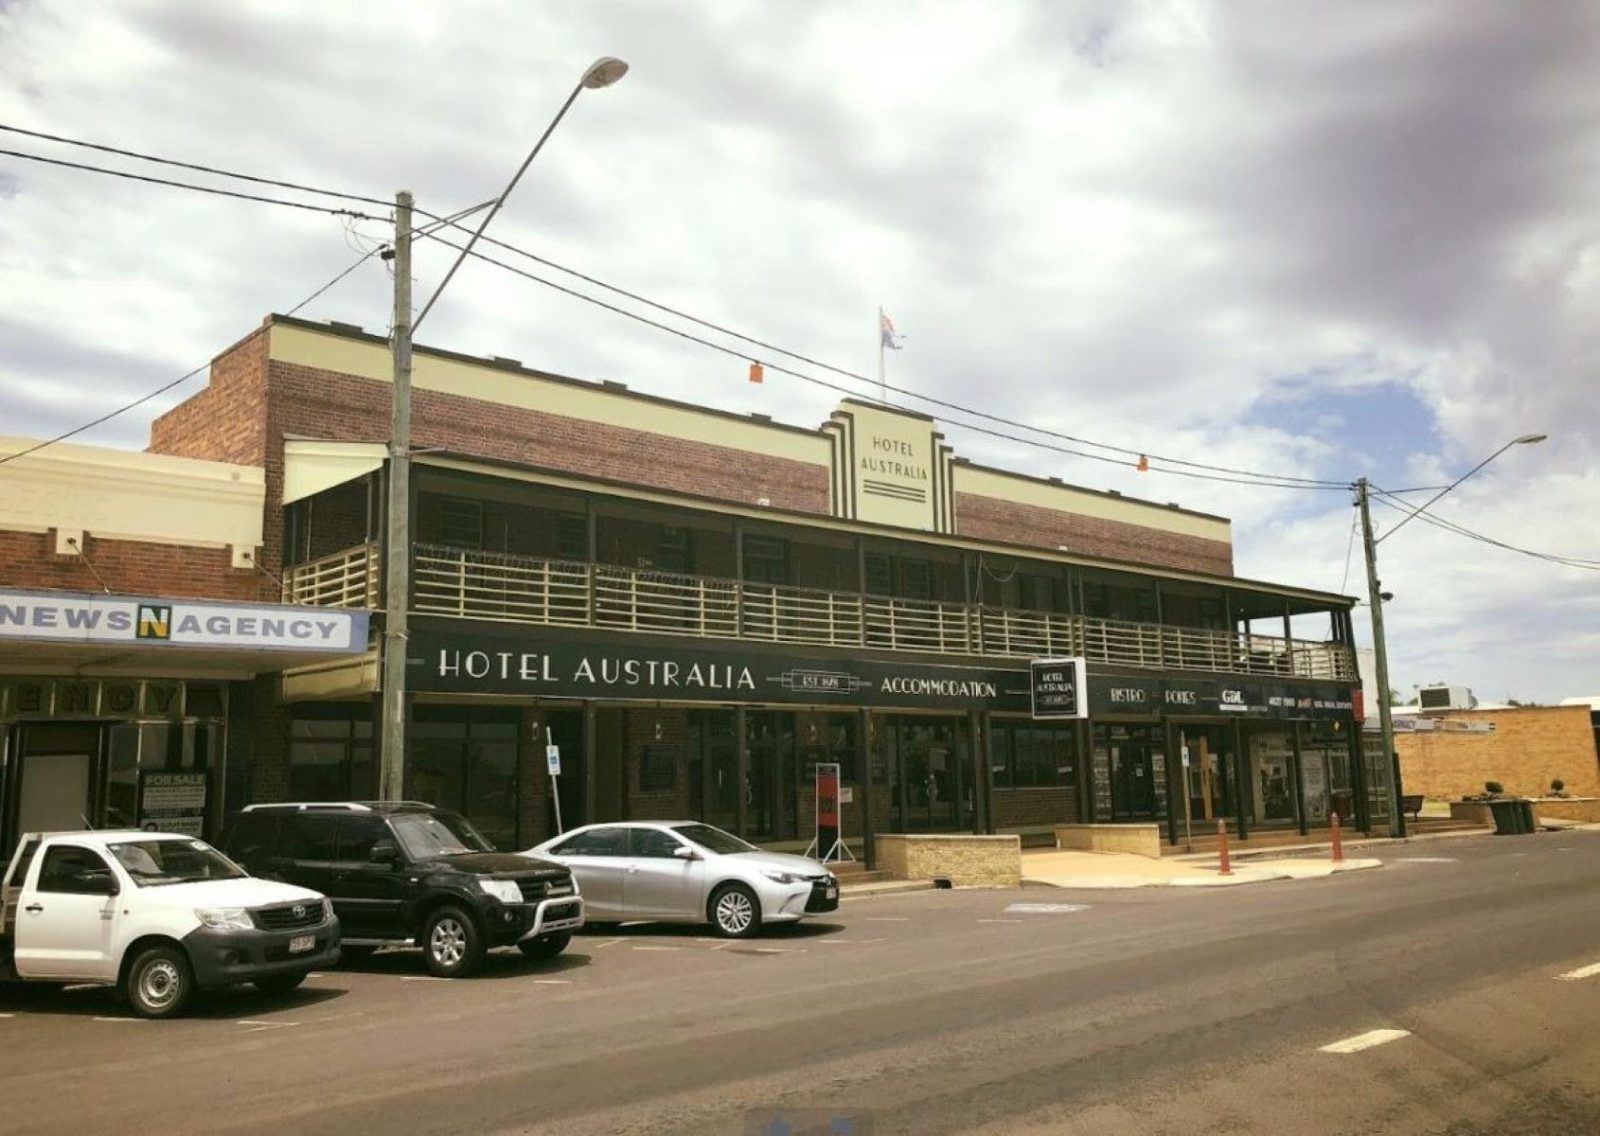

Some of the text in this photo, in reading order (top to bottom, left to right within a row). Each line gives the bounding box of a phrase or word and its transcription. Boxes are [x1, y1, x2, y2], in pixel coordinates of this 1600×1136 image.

[873, 436, 914, 457] HOTEL
[861, 457, 928, 481] AUSTRALIA
[0, 605, 132, 631] NEWS
[177, 614, 337, 639] AGENCY
[438, 649, 756, 690] HOTEL AUSTRALIA
[880, 677, 997, 698] ACCOMMODATION
[1110, 687, 1145, 703] BISTRO
